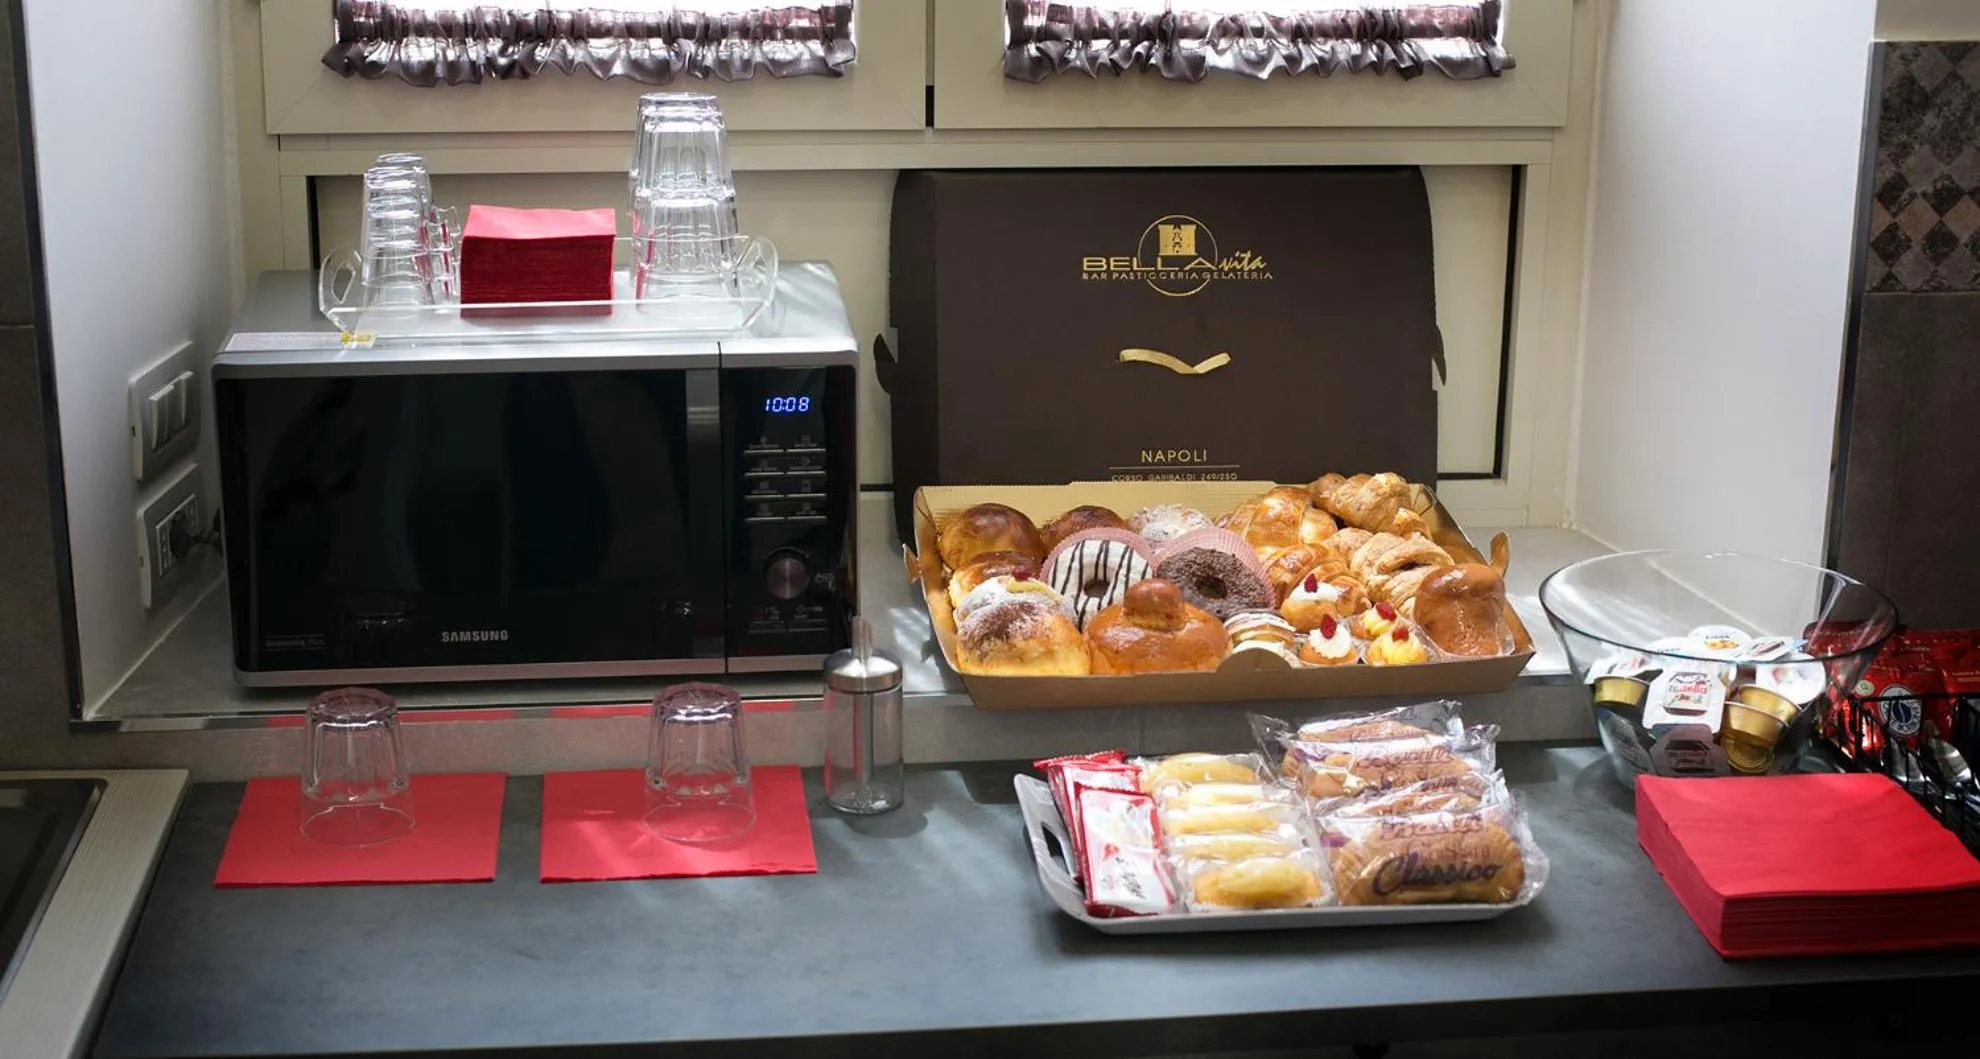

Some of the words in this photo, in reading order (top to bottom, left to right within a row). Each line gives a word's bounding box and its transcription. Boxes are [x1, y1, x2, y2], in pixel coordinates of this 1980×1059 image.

[1082, 256, 1218, 271] BELLA
[1218, 250, 1267, 272] vita
[1082, 271, 1108, 280] BAR
[1112, 271, 1200, 280] PASTICCERIA
[1202, 271, 1273, 280] GELATERIA
[765, 396, 810, 413] 10:08
[1141, 449, 1207, 463] NAPOLI
[441, 629, 509, 643] SAMSUNG
